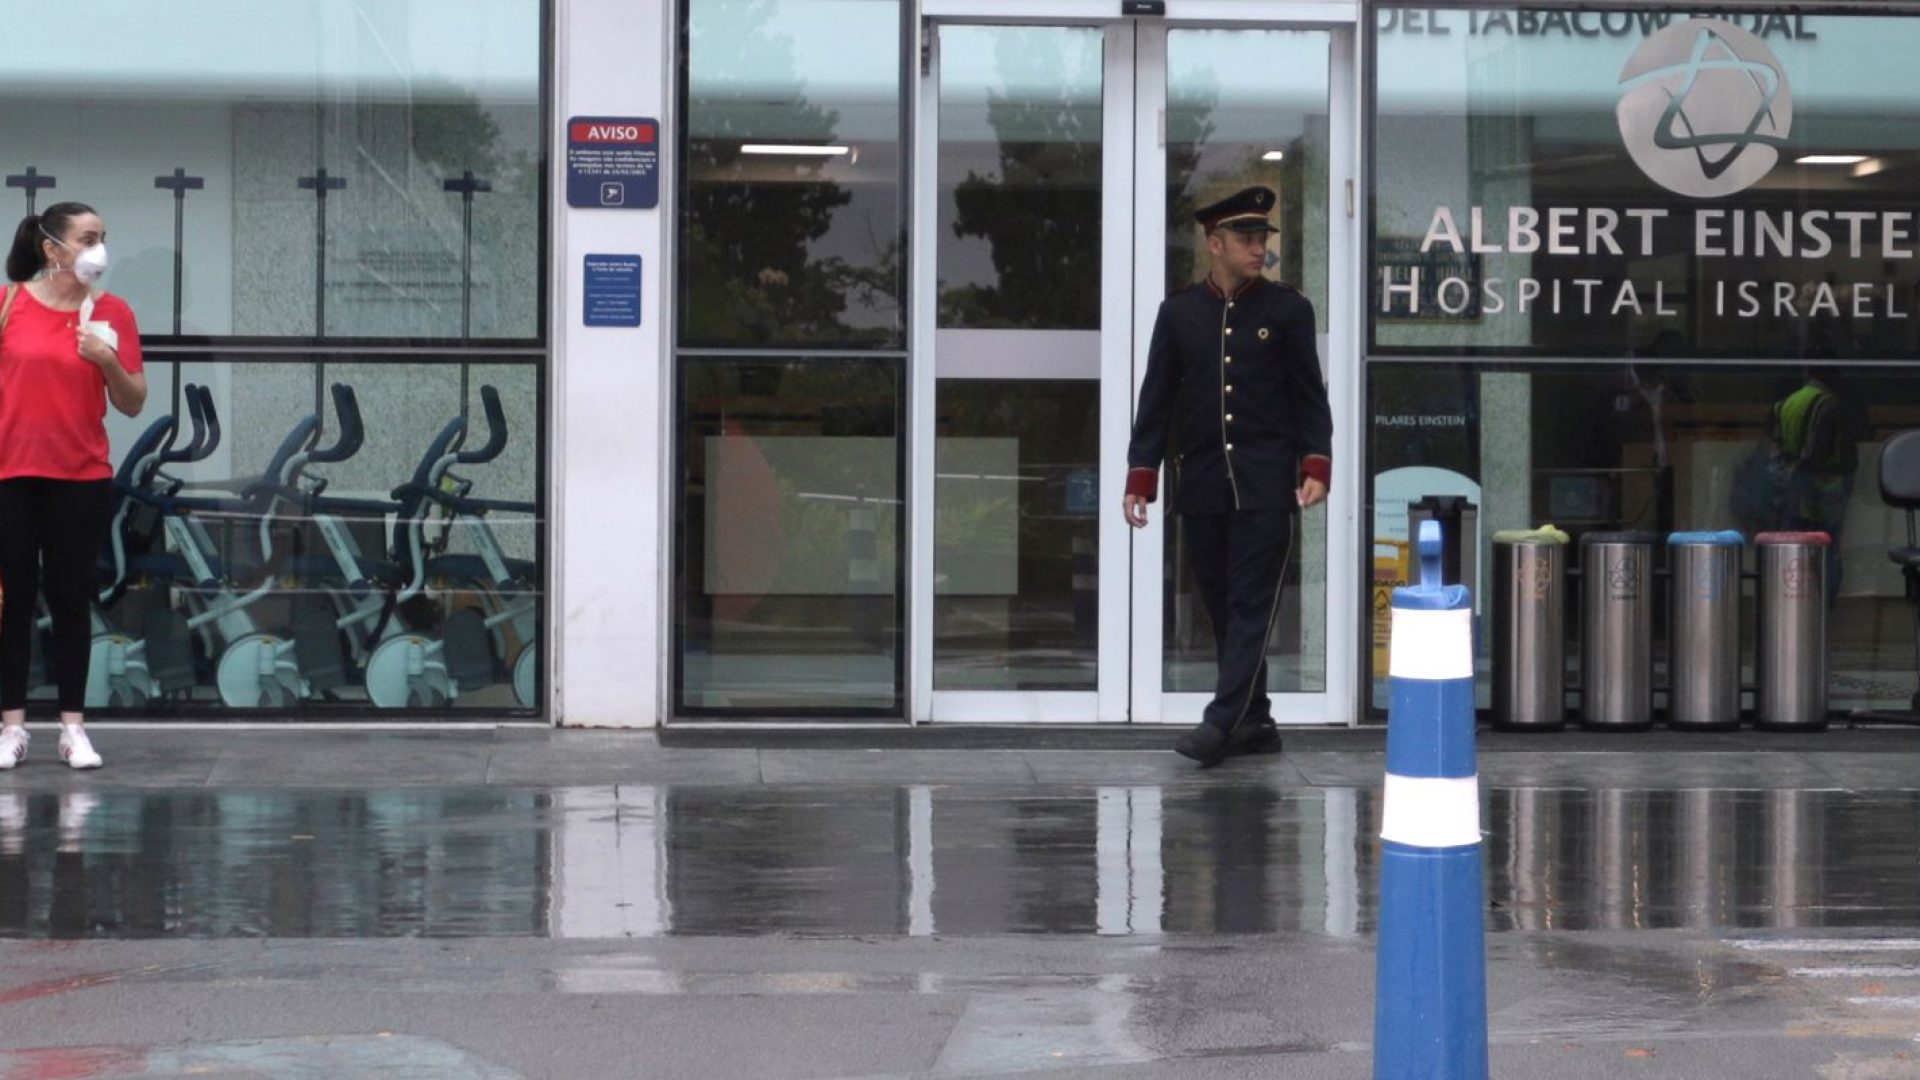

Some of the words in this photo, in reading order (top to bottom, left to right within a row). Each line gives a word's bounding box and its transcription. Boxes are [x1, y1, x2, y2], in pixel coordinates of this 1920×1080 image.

[588, 126, 638, 140] AVISO
[1420, 206, 1669, 255] ALBERT
[1695, 209, 1913, 258] EINSTE
[1382, 266, 1677, 316] HOSPITAL
[1717, 281, 1908, 318] ISRAEL
[1375, 415, 1415, 426] PILARES
[1419, 415, 1465, 426] EINSTEIN
